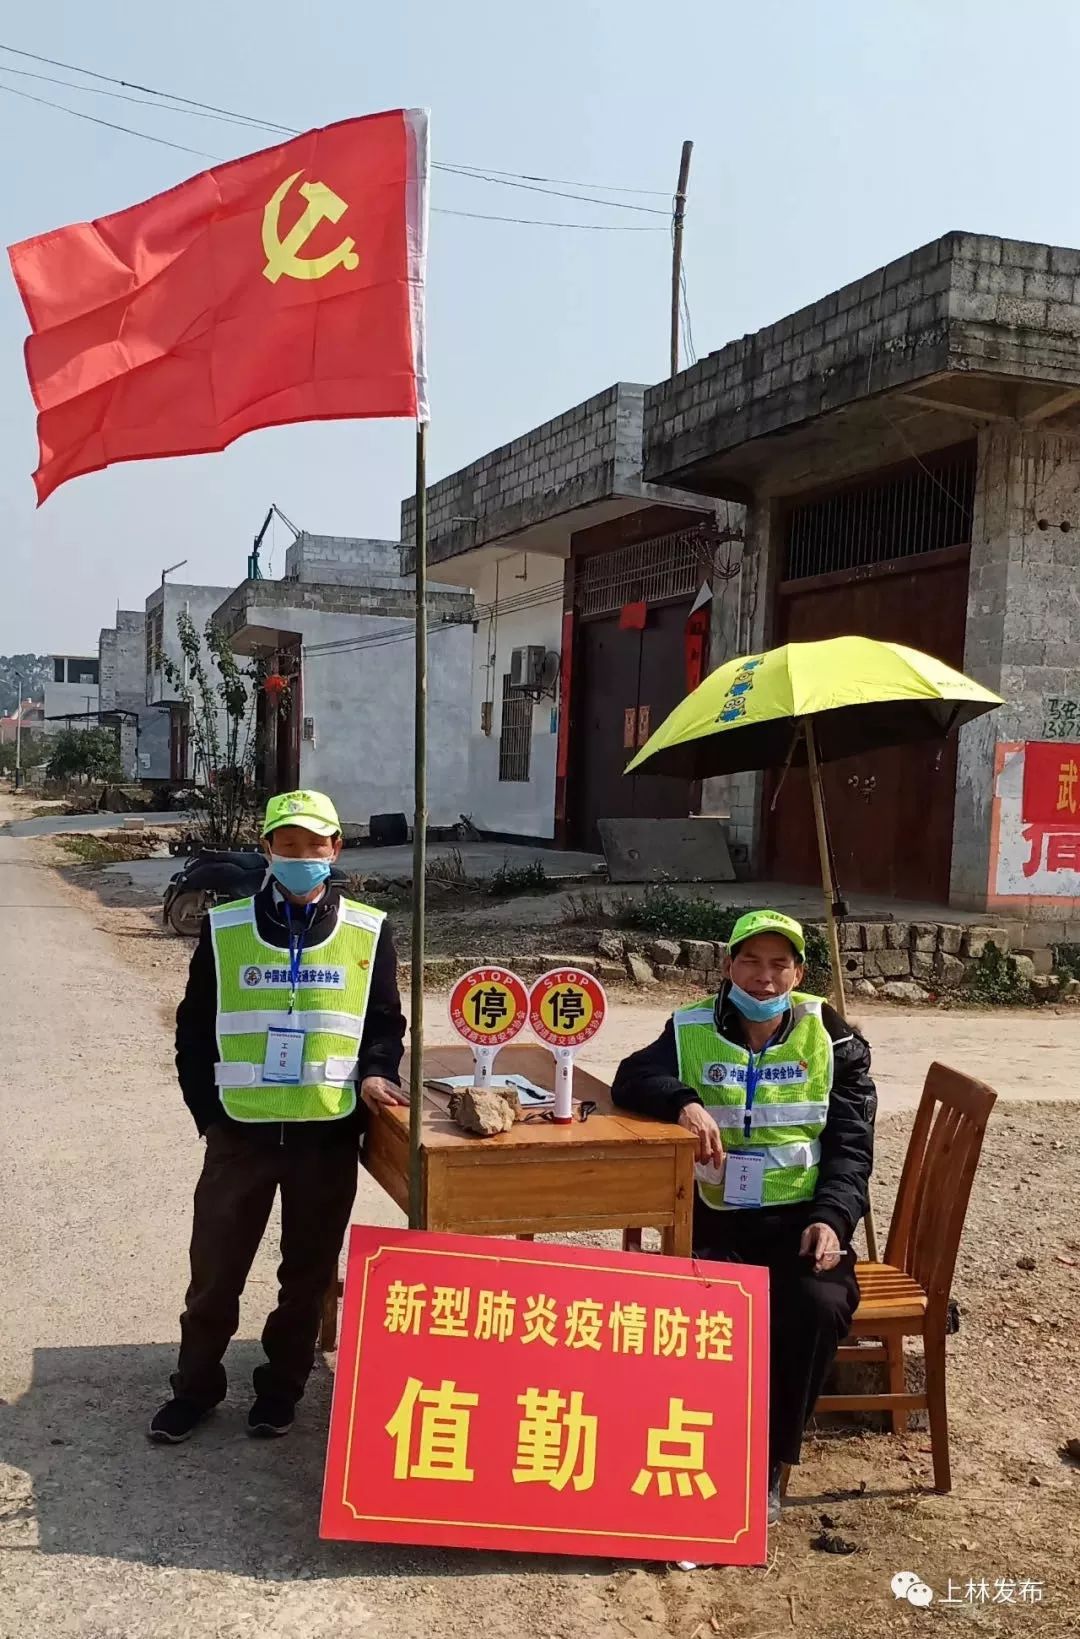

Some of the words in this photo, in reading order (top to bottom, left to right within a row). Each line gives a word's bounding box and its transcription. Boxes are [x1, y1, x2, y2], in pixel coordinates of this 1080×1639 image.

[467, 972, 514, 986] STOP
[543, 973, 589, 989] STOP
[470, 986, 507, 1028] 停
[547, 987, 585, 1029] 停
[730, 1066, 803, 1082] 中国交通安全协会
[383, 1279, 734, 1362] 新型肺炎疫情防控
[385, 1376, 718, 1501] 值勤点
